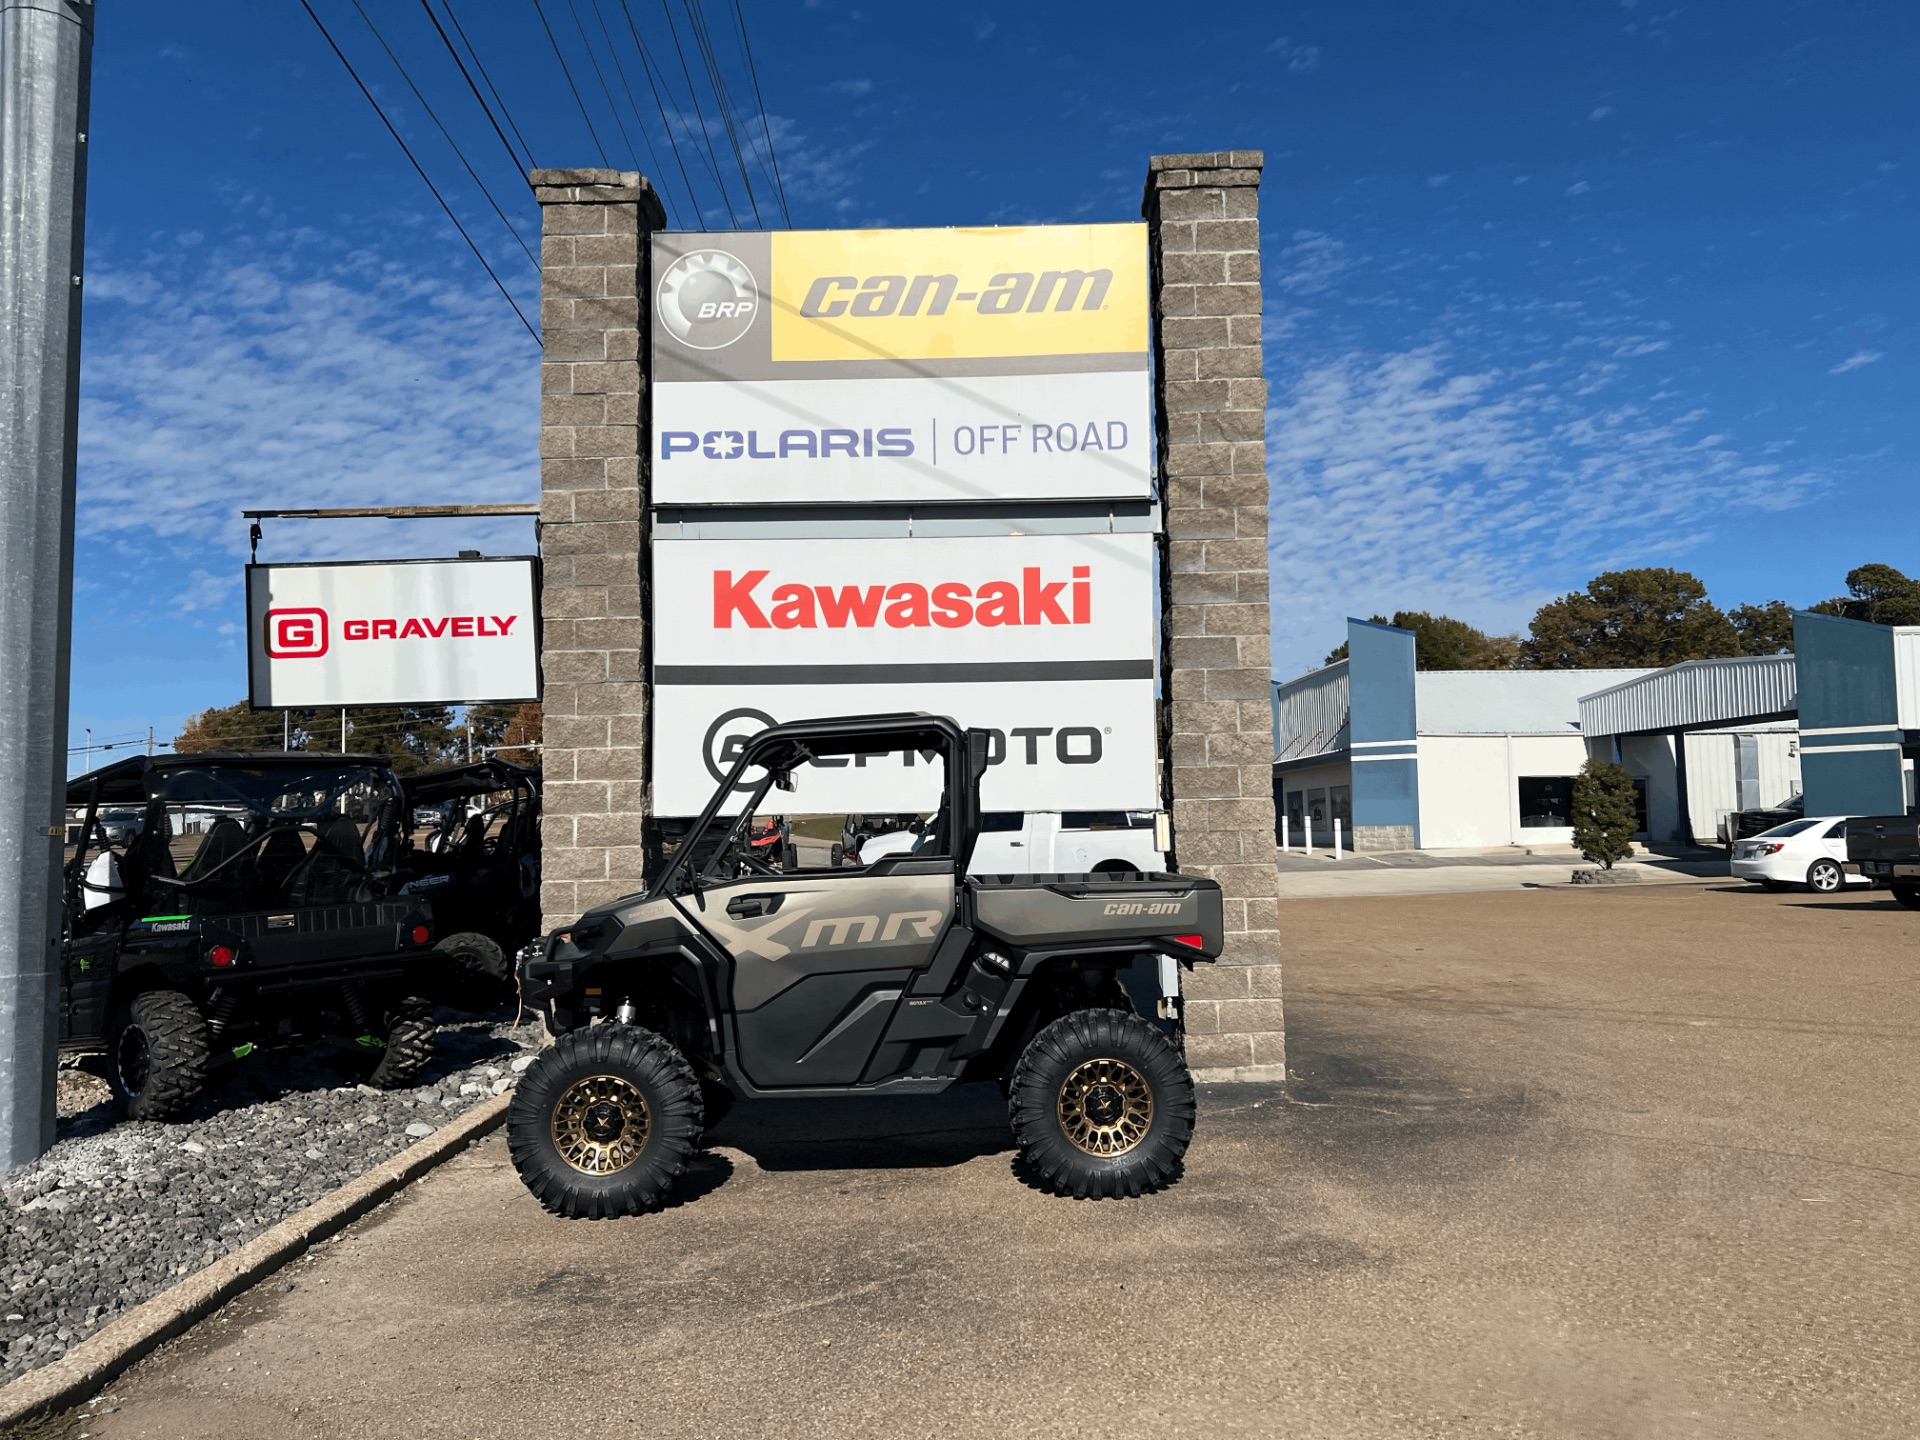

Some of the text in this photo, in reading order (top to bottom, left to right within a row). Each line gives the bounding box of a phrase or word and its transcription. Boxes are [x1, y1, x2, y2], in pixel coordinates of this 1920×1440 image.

[799, 268, 1114, 318] can-am
[697, 302, 753, 319] BRP
[660, 420, 1128, 460] POLARIS OFF ROAD
[713, 565, 1091, 630] Kawasaki
[278, 615, 518, 647] G GRAVELY
[409, 874, 450, 889] NEER
[1103, 903, 1182, 915] can-am
[151, 920, 190, 932] Kawasaki
